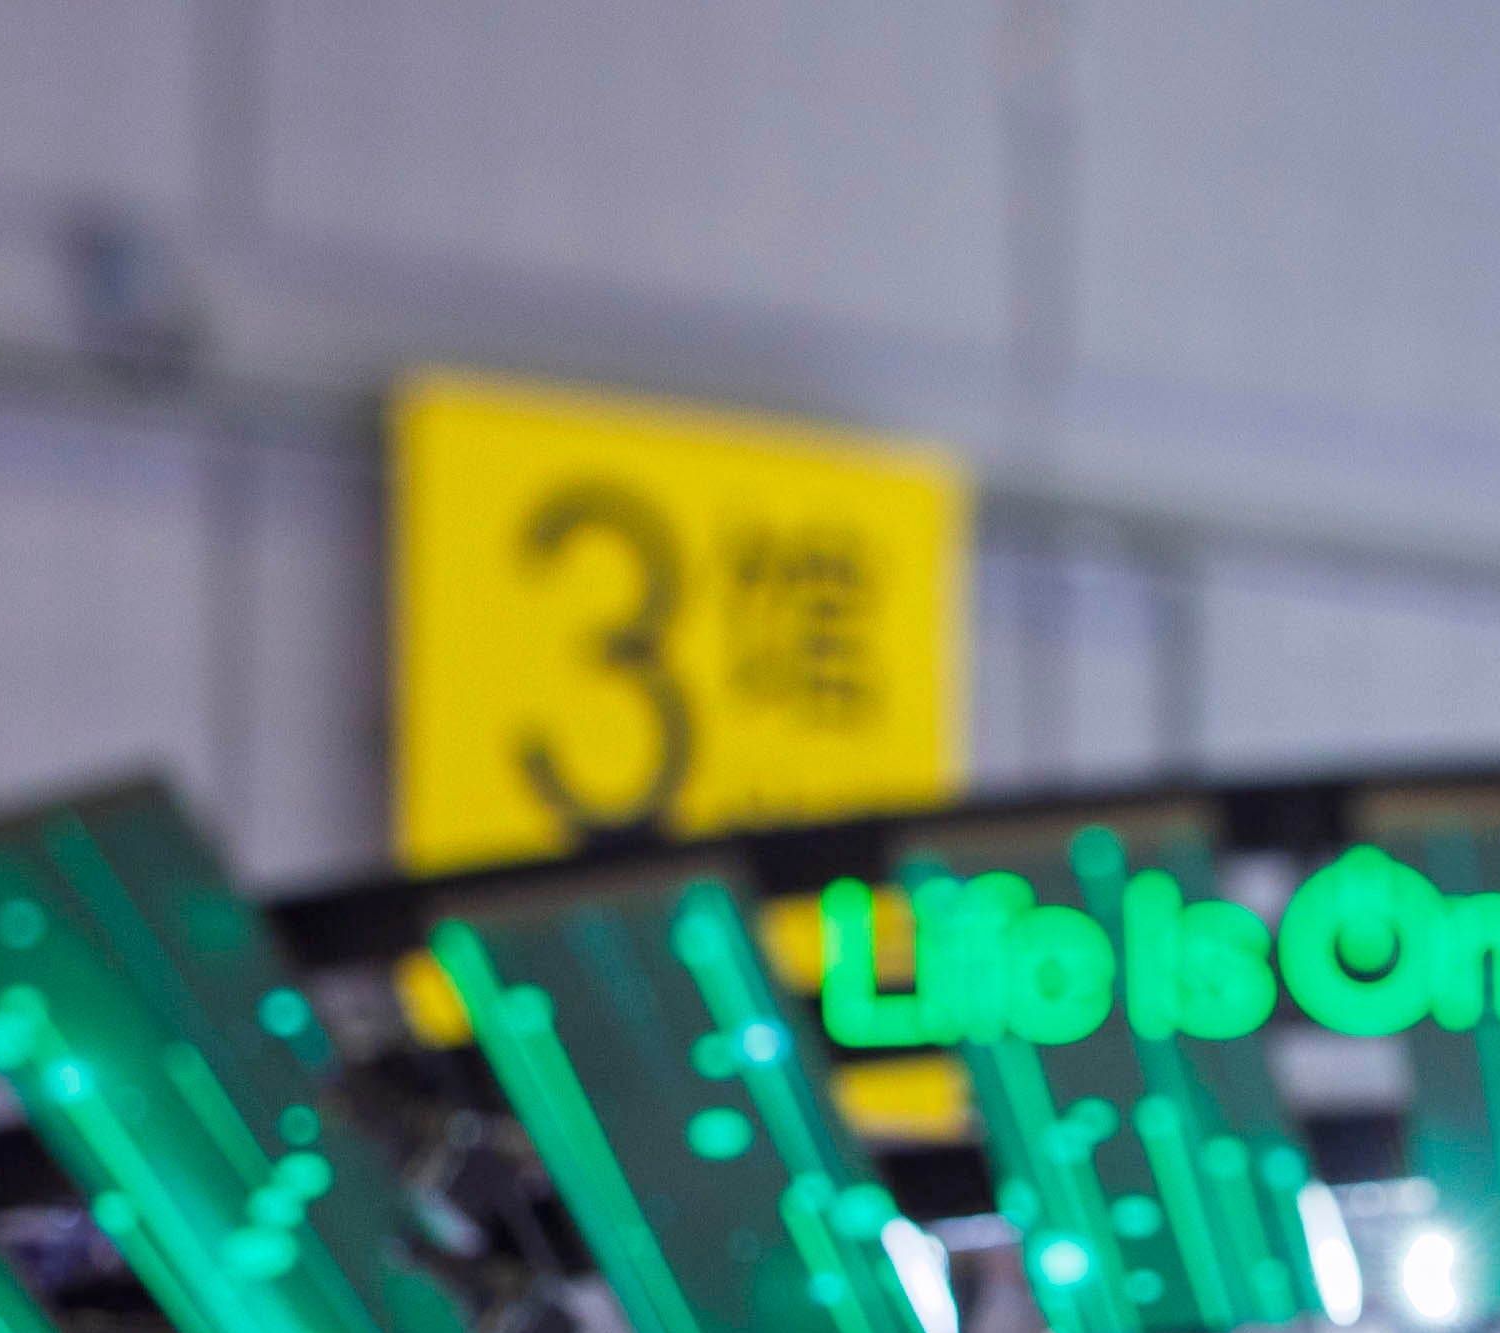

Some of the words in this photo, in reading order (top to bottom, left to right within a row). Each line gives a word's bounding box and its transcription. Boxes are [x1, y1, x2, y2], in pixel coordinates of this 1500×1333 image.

[512, 475, 700, 838] 3
[823, 872, 1114, 1046] Life
[1124, 868, 1277, 1041] Is
